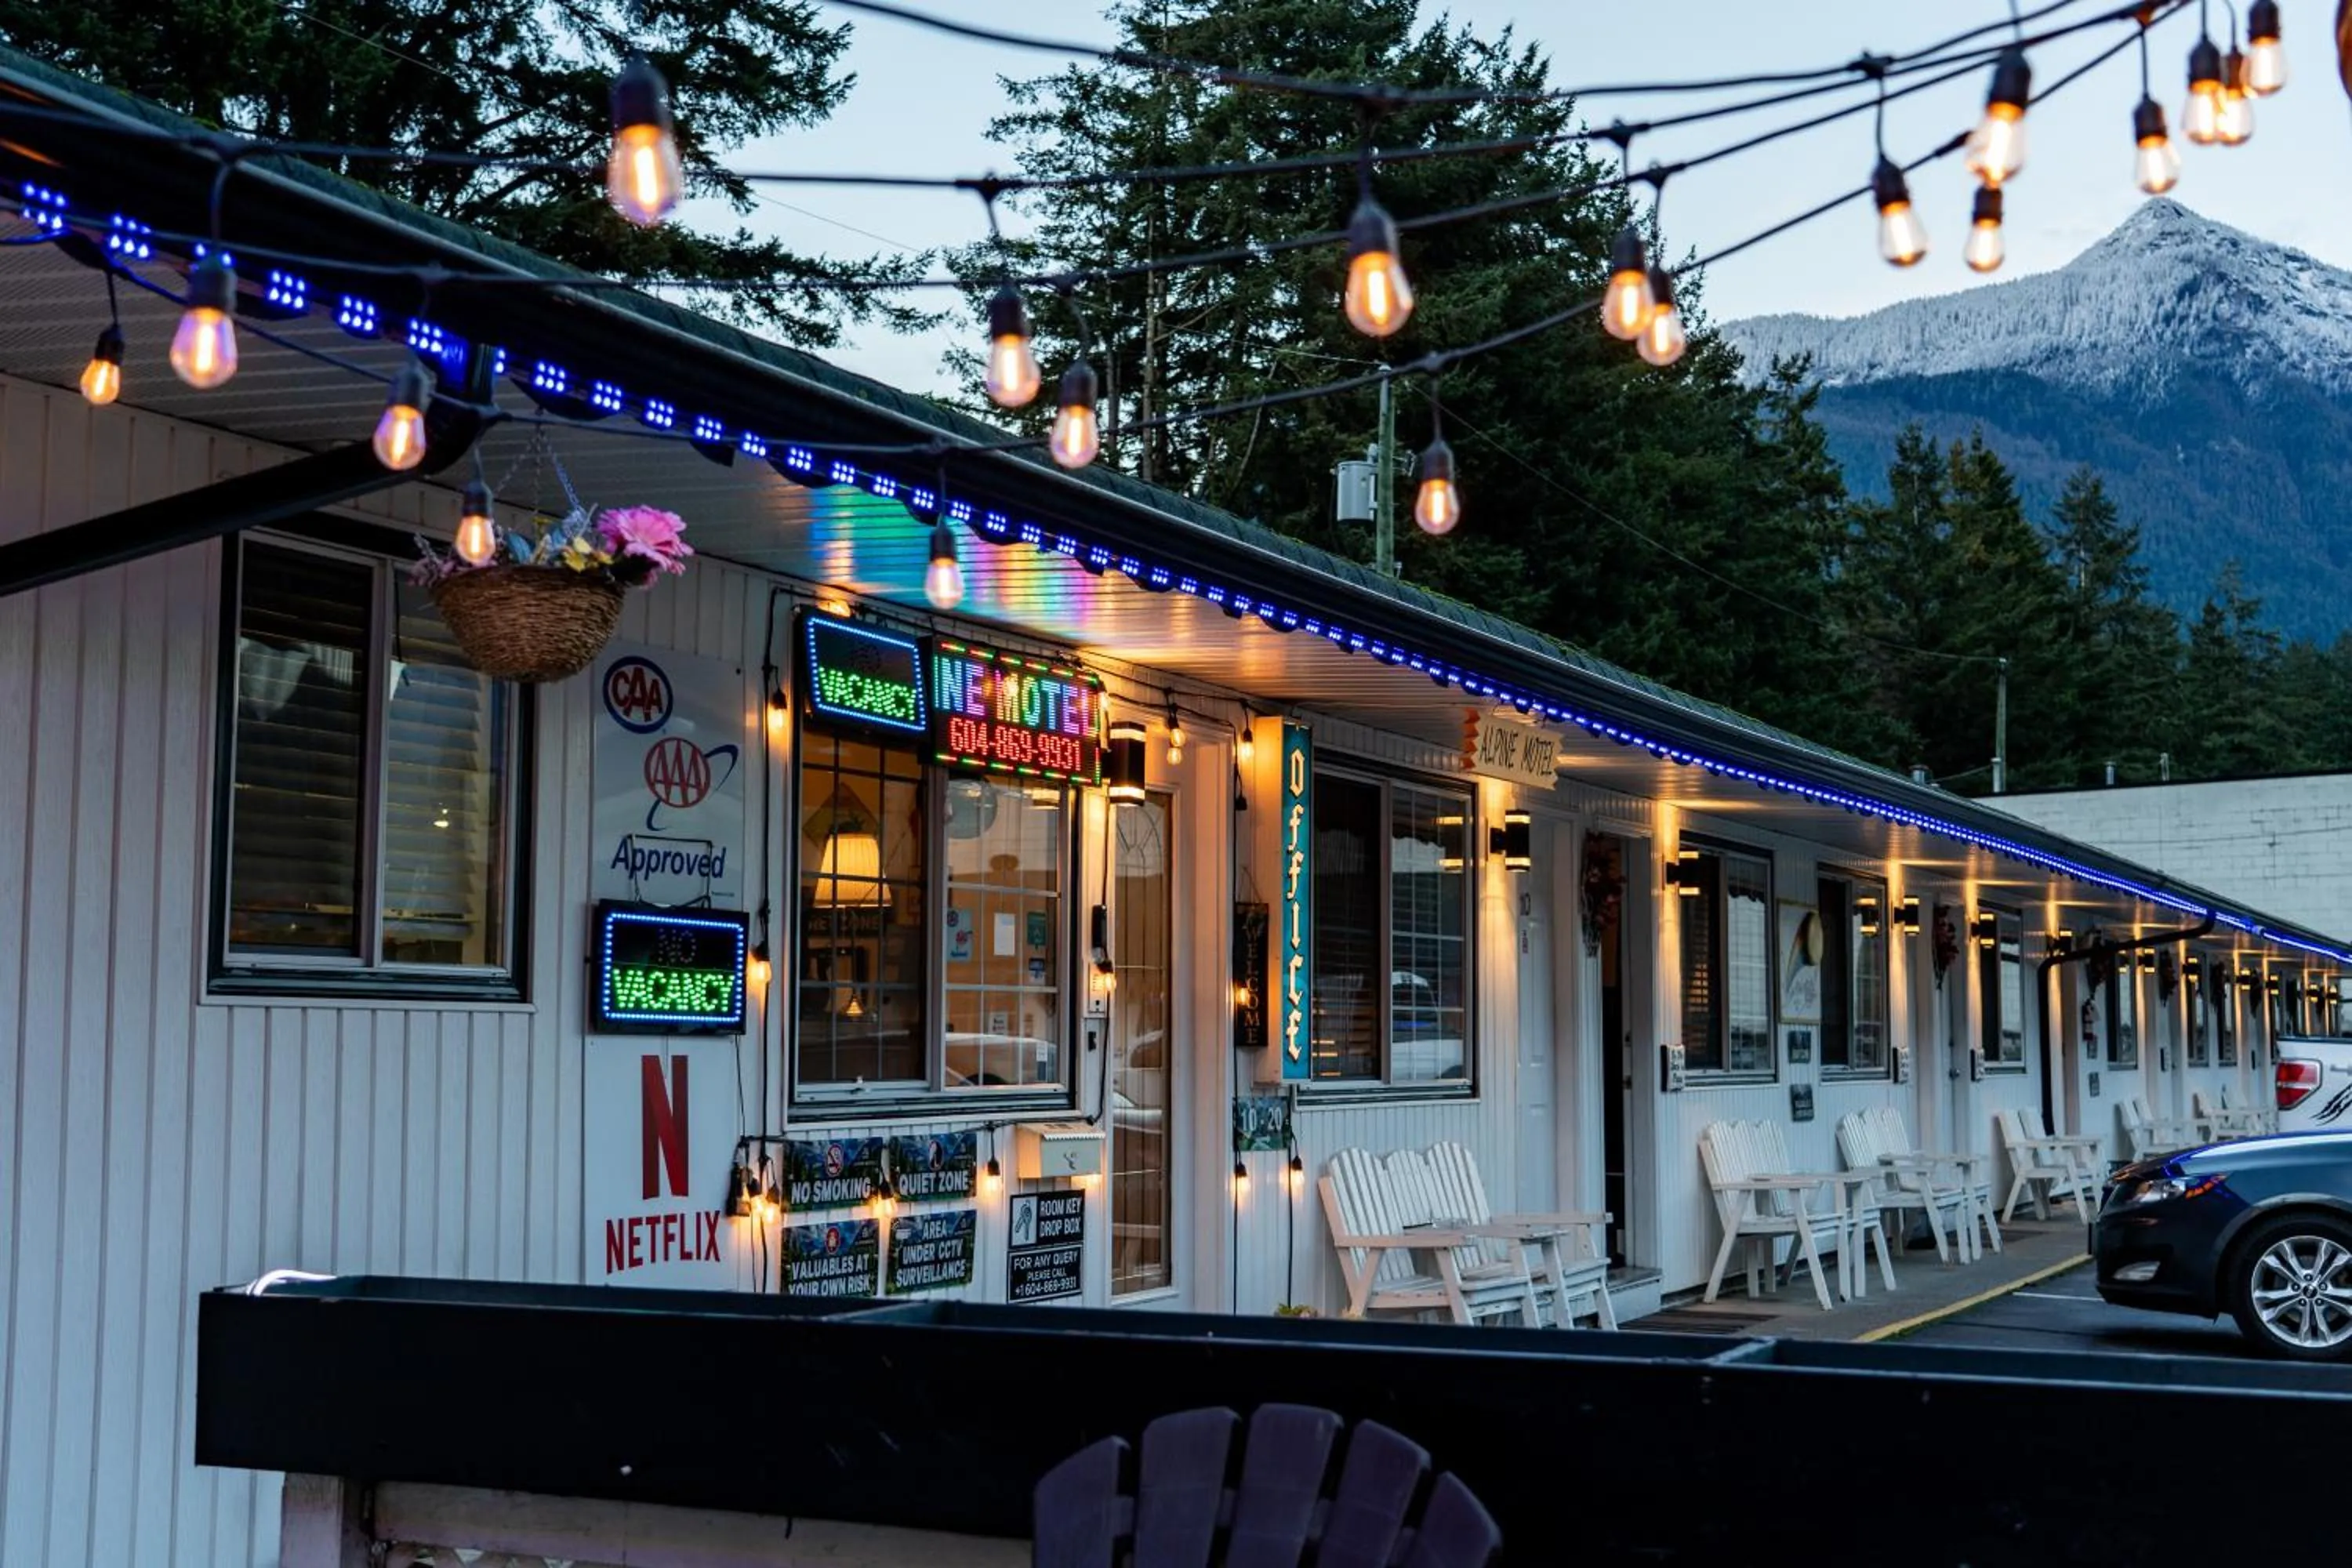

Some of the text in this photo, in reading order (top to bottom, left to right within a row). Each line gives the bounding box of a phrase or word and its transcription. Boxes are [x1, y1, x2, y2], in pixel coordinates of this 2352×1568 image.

[612, 666, 663, 722] CAA
[818, 667, 916, 720] VACANCY
[995, 670, 1098, 739] MOTEL
[949, 717, 1081, 771] 604-869-9931
[1480, 725, 1555, 776] ALPINE MOTEL
[648, 739, 709, 808] AAA
[610, 836, 727, 881] Approved
[612, 969, 735, 1012] VACANCY
[641, 1054, 689, 1200] N
[1241, 1107, 1257, 1131] 10
[1268, 1106, 1283, 1131] 20
[791, 1177, 871, 1205] NO SMOKING
[899, 1171, 968, 1196] QUIET ZONE
[1040, 1197, 1083, 1217] ROOM KEY
[922, 1219, 947, 1240] AREA
[1039, 1217, 1081, 1238] DROP BOX
[605, 1210, 720, 1276] NETFLIX
[902, 1239, 964, 1265] UNDER CCTV
[792, 1254, 869, 1280] VALUABLES AT
[896, 1258, 966, 1287] SURVEILLANCE
[1014, 1250, 1078, 1270] FOR ANY QUERY
[788, 1273, 872, 1296] YOUR OWN RISK
[1027, 1268, 1067, 1281] PLEASE CALL
